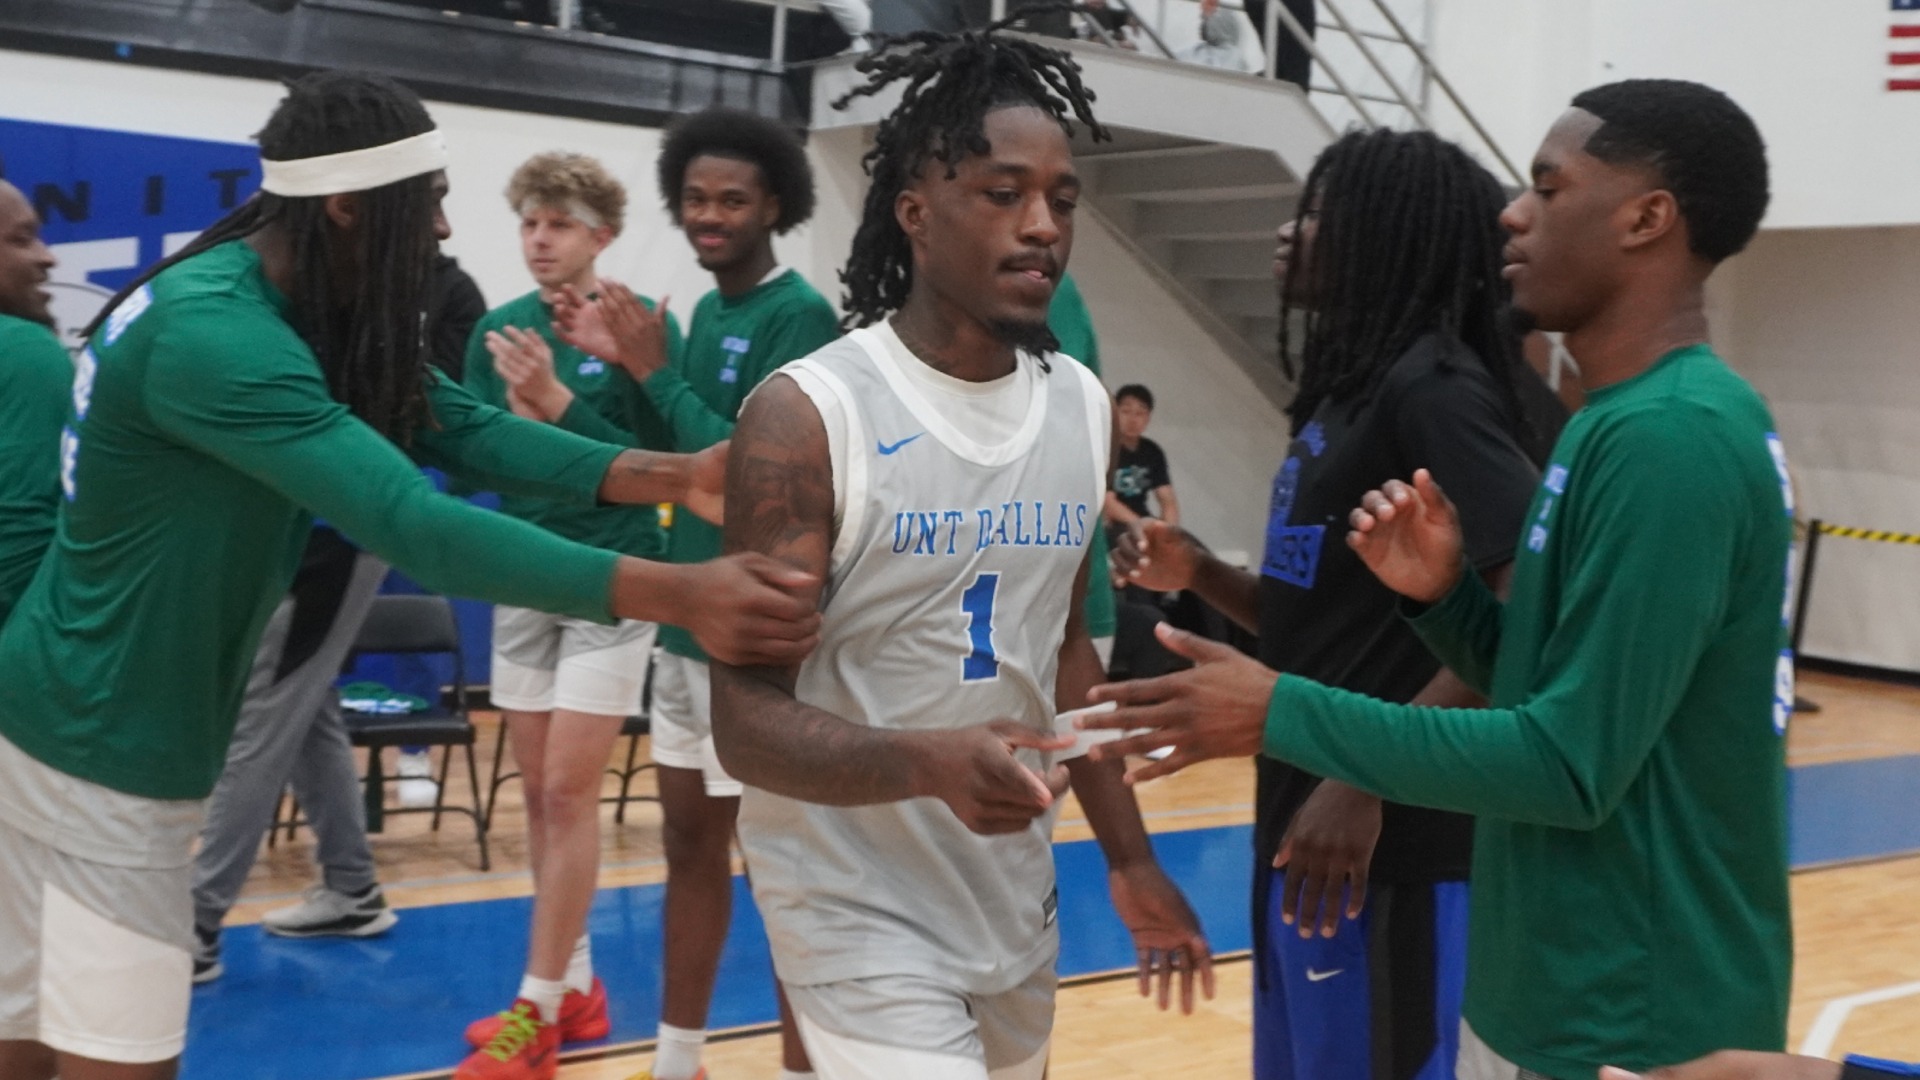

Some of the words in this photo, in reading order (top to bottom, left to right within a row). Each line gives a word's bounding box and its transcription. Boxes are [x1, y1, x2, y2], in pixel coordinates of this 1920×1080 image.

[892, 510, 963, 555] UNT
[975, 500, 1087, 553] DALLAS
[959, 571, 1002, 685] 1
